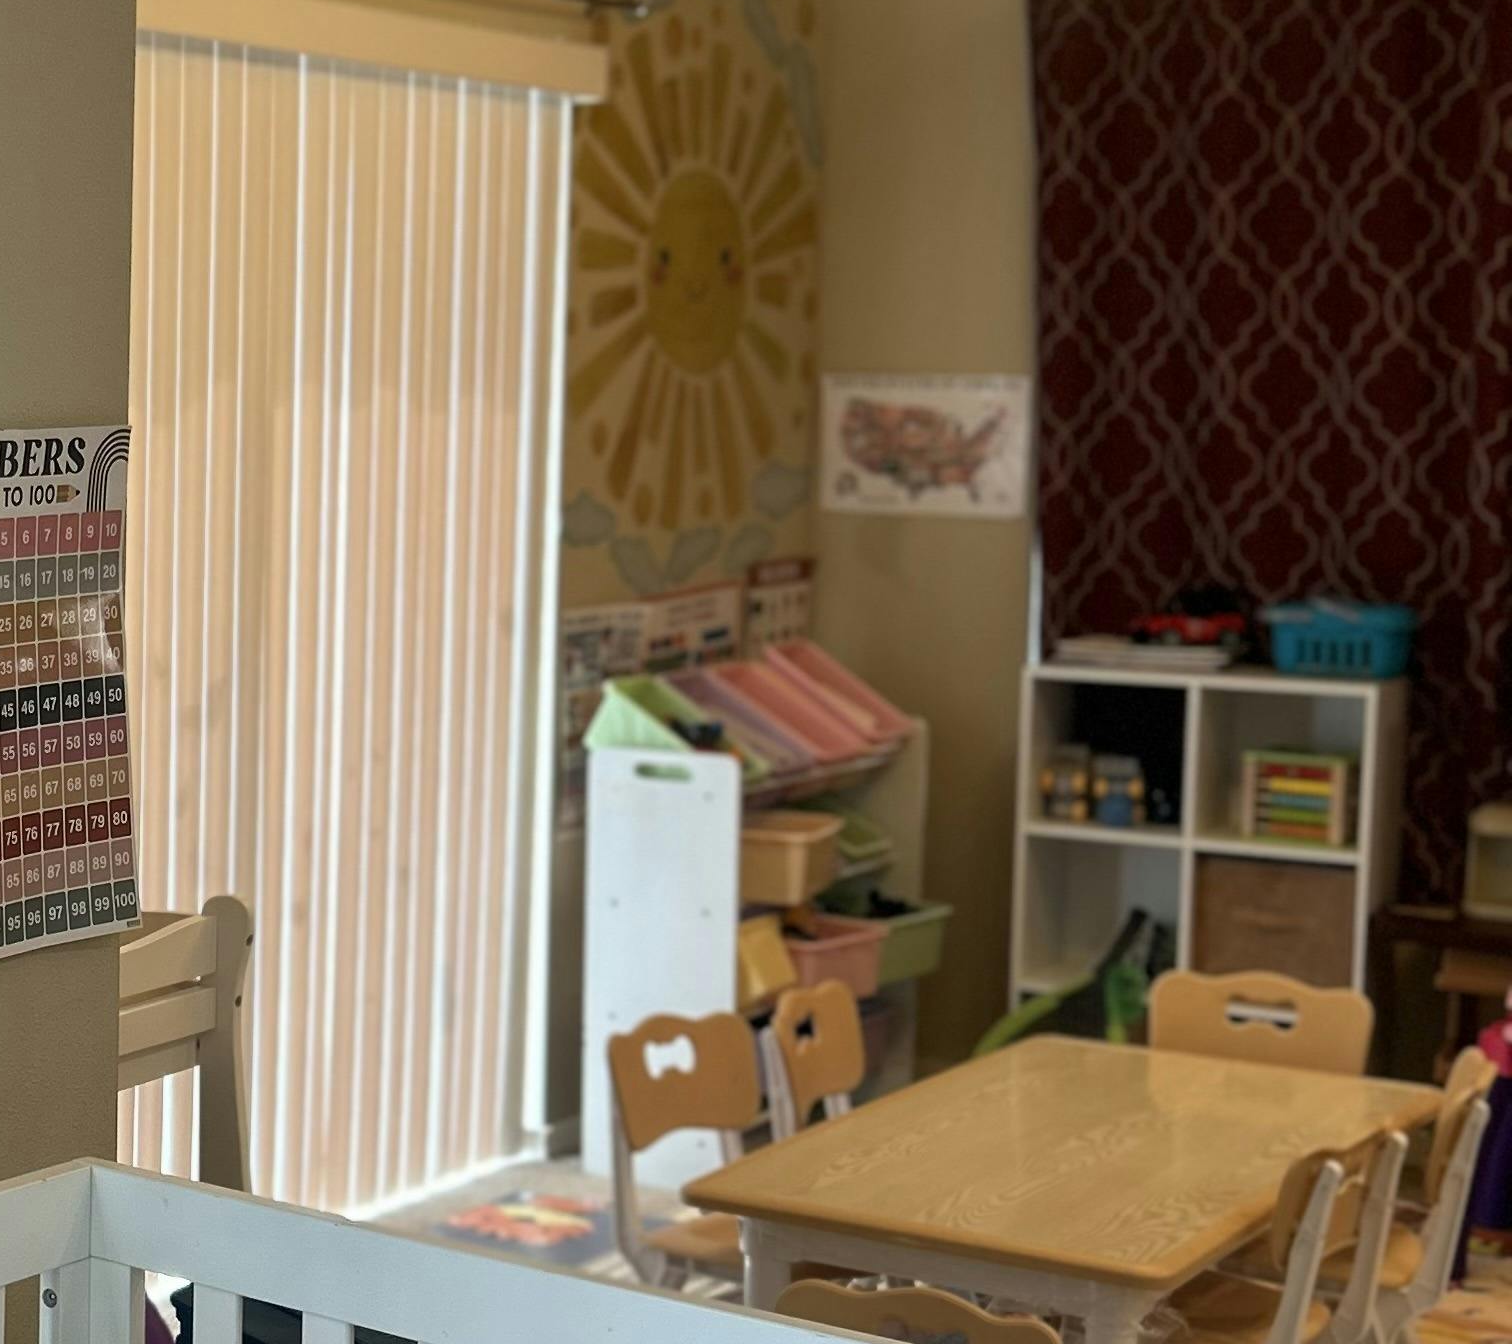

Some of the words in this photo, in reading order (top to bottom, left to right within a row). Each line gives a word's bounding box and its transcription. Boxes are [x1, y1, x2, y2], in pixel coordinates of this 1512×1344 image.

[3, 486, 23, 507] TO
[29, 484, 55, 505] 100
[42, 696, 57, 712] 47
[65, 693, 80, 708] 48
[87, 690, 102, 706] 49
[108, 687, 123, 703] 50
